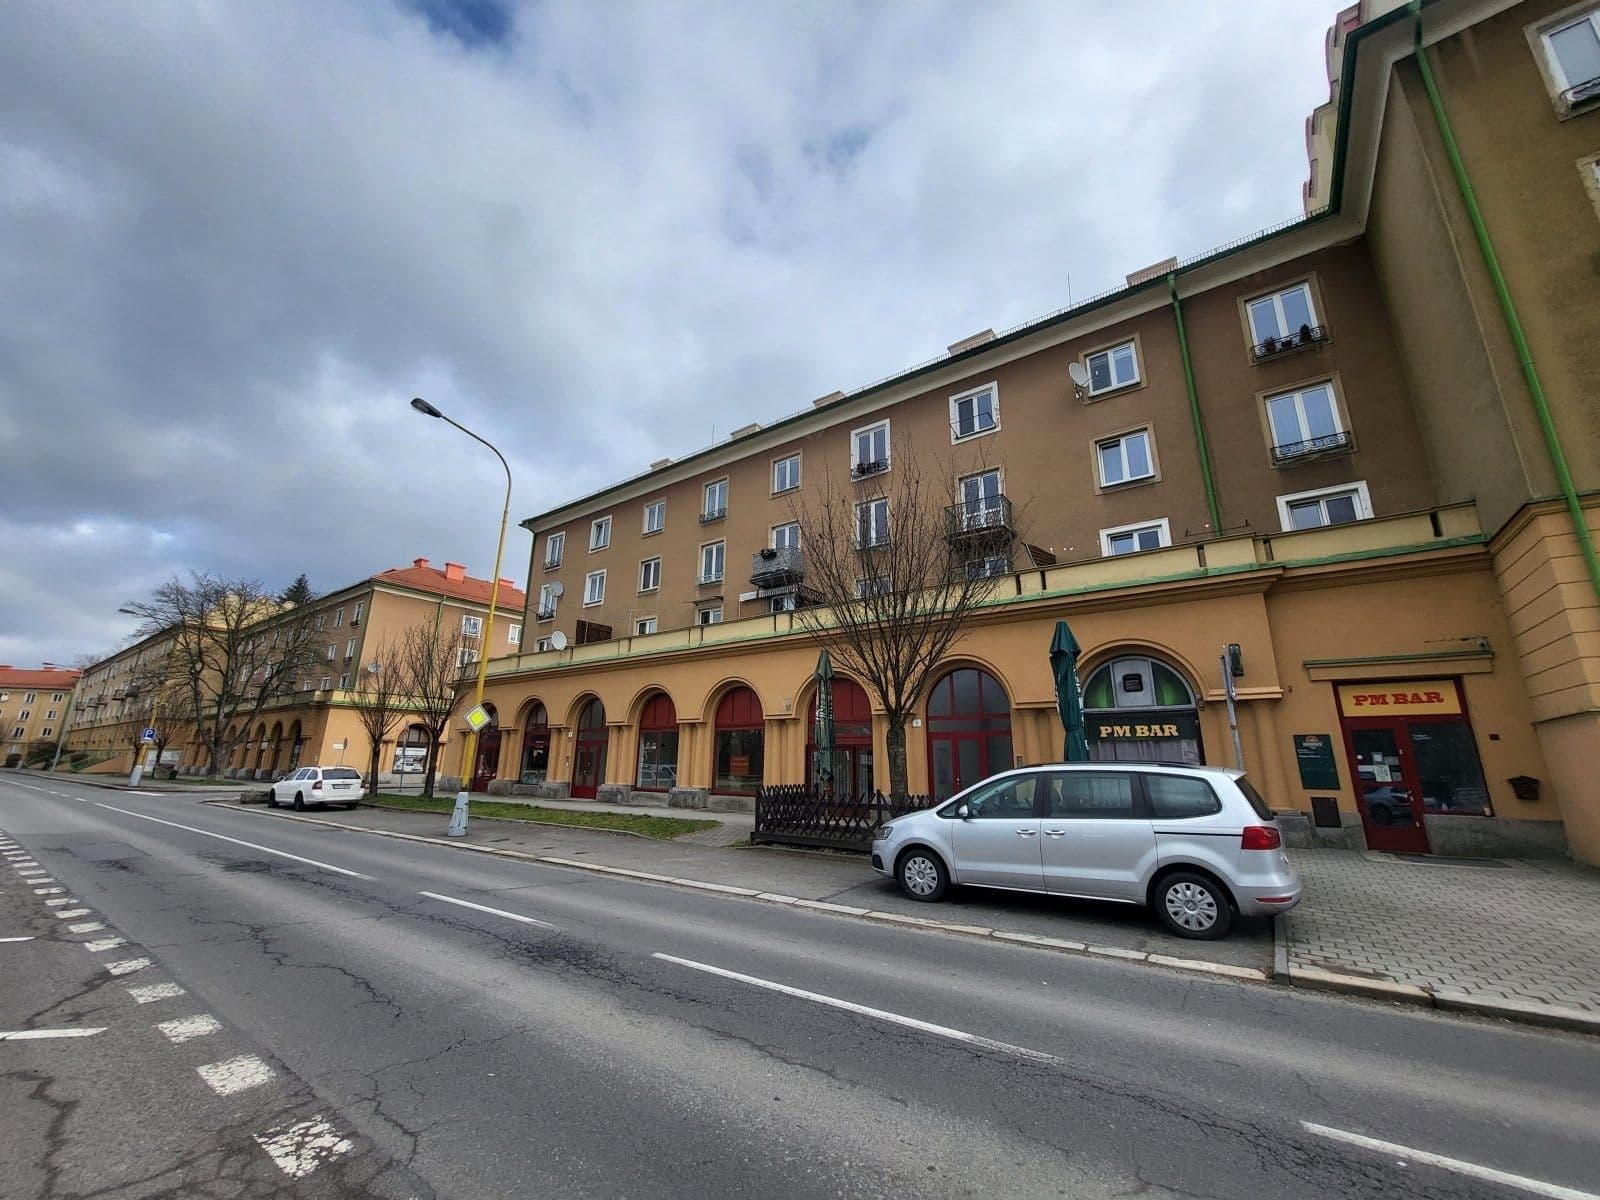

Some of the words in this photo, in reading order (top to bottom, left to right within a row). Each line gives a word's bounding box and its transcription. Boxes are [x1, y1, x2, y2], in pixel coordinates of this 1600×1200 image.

[1353, 694, 1389, 706] PM
[1391, 692, 1444, 704] BAR
[1099, 725, 1131, 737] PM
[1135, 724, 1179, 737] BAR
